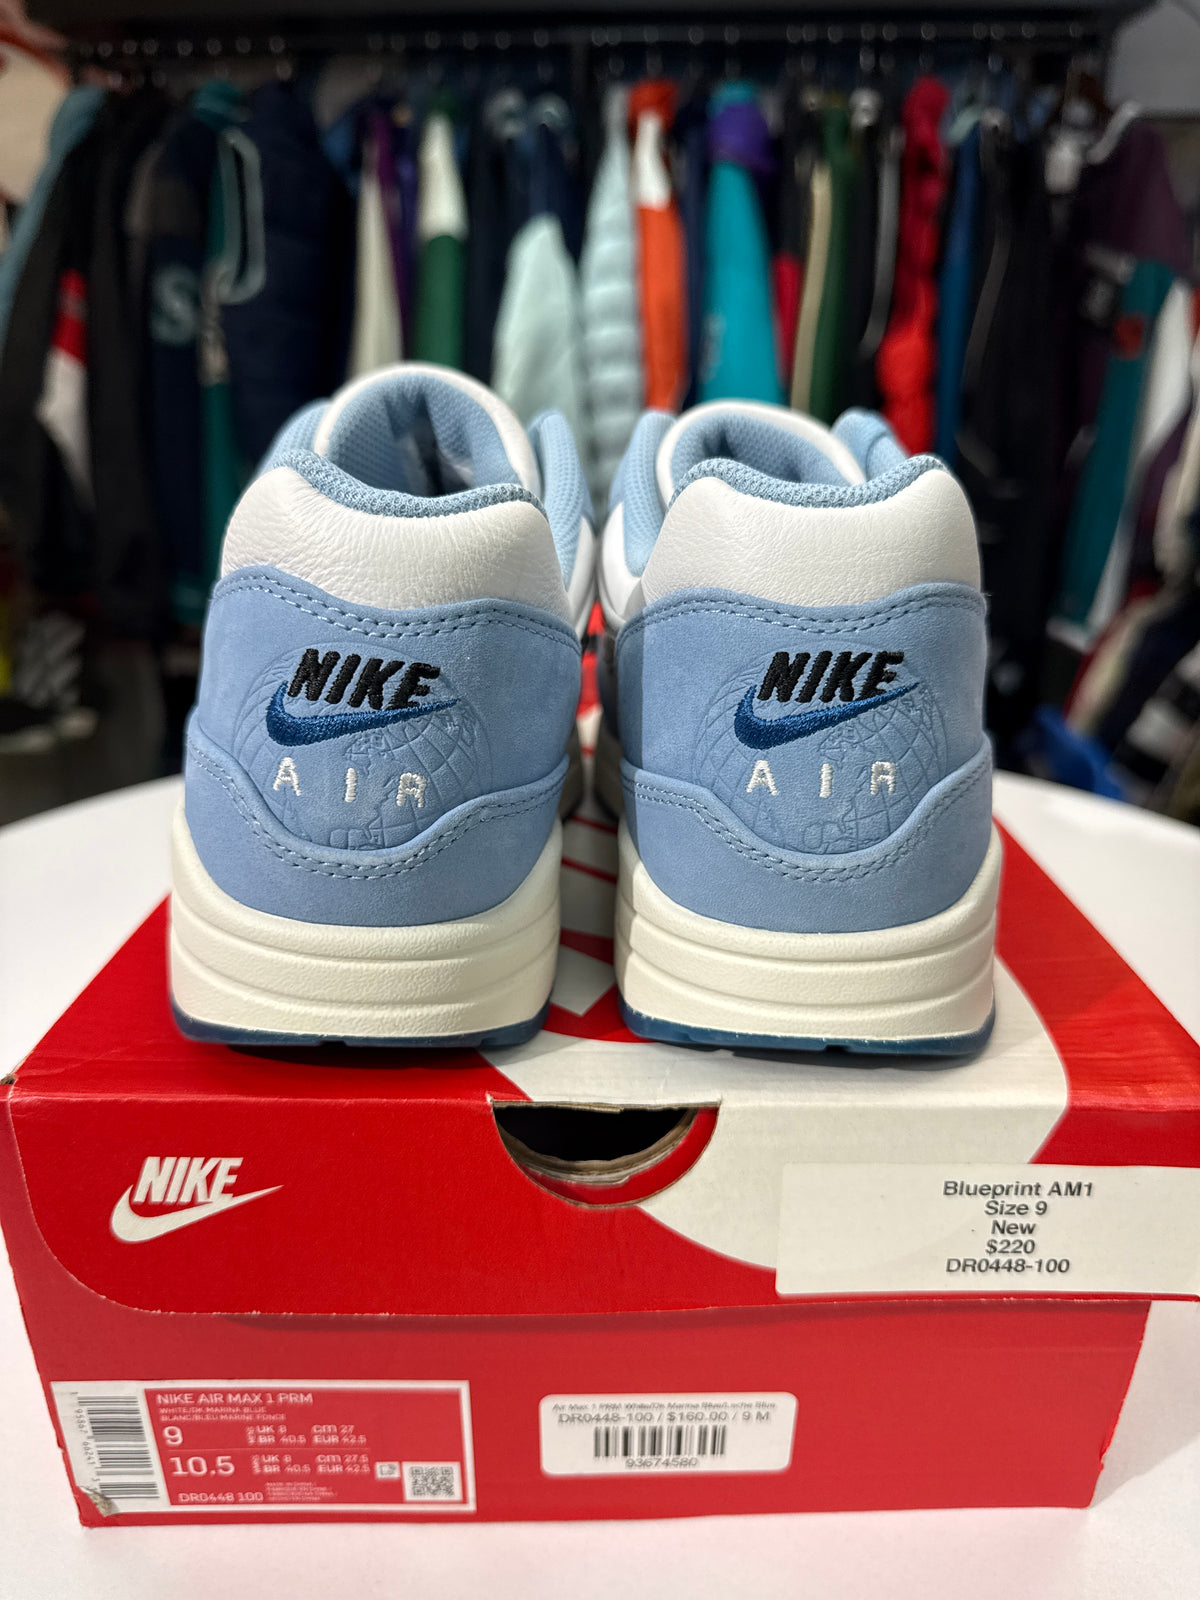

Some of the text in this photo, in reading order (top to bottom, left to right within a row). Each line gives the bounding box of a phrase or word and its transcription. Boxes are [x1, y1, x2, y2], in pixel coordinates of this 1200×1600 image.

[288, 648, 440, 710] NIKE
[757, 650, 905, 703] NIKE
[132, 1156, 243, 1204] NIKE
[943, 1181, 1093, 1199] Blueprint AM1
[984, 1200, 1047, 1215] Size 9
[991, 1220, 1036, 1234] New
[985, 1239, 1036, 1254] $220
[945, 1258, 1070, 1273] DR0448-100
[156, 1393, 313, 1404] NIKE AIR MAX 1 PRM
[558, 1412, 652, 1423] DR0448-100
[667, 1411, 726, 1422] $160.00
[742, 1411, 752, 1421] 9
[756, 1411, 770, 1421] M
[163, 1426, 183, 1446] 9
[256, 1425, 275, 1433] UK
[258, 1435, 275, 1443] BR
[313, 1435, 339, 1443] EUR
[170, 1456, 235, 1476] 10.5
[263, 1465, 280, 1473] BR
[318, 1465, 343, 1473] EUR
[626, 1456, 698, 1468] 93674580
[238, 1492, 264, 1502] 100
